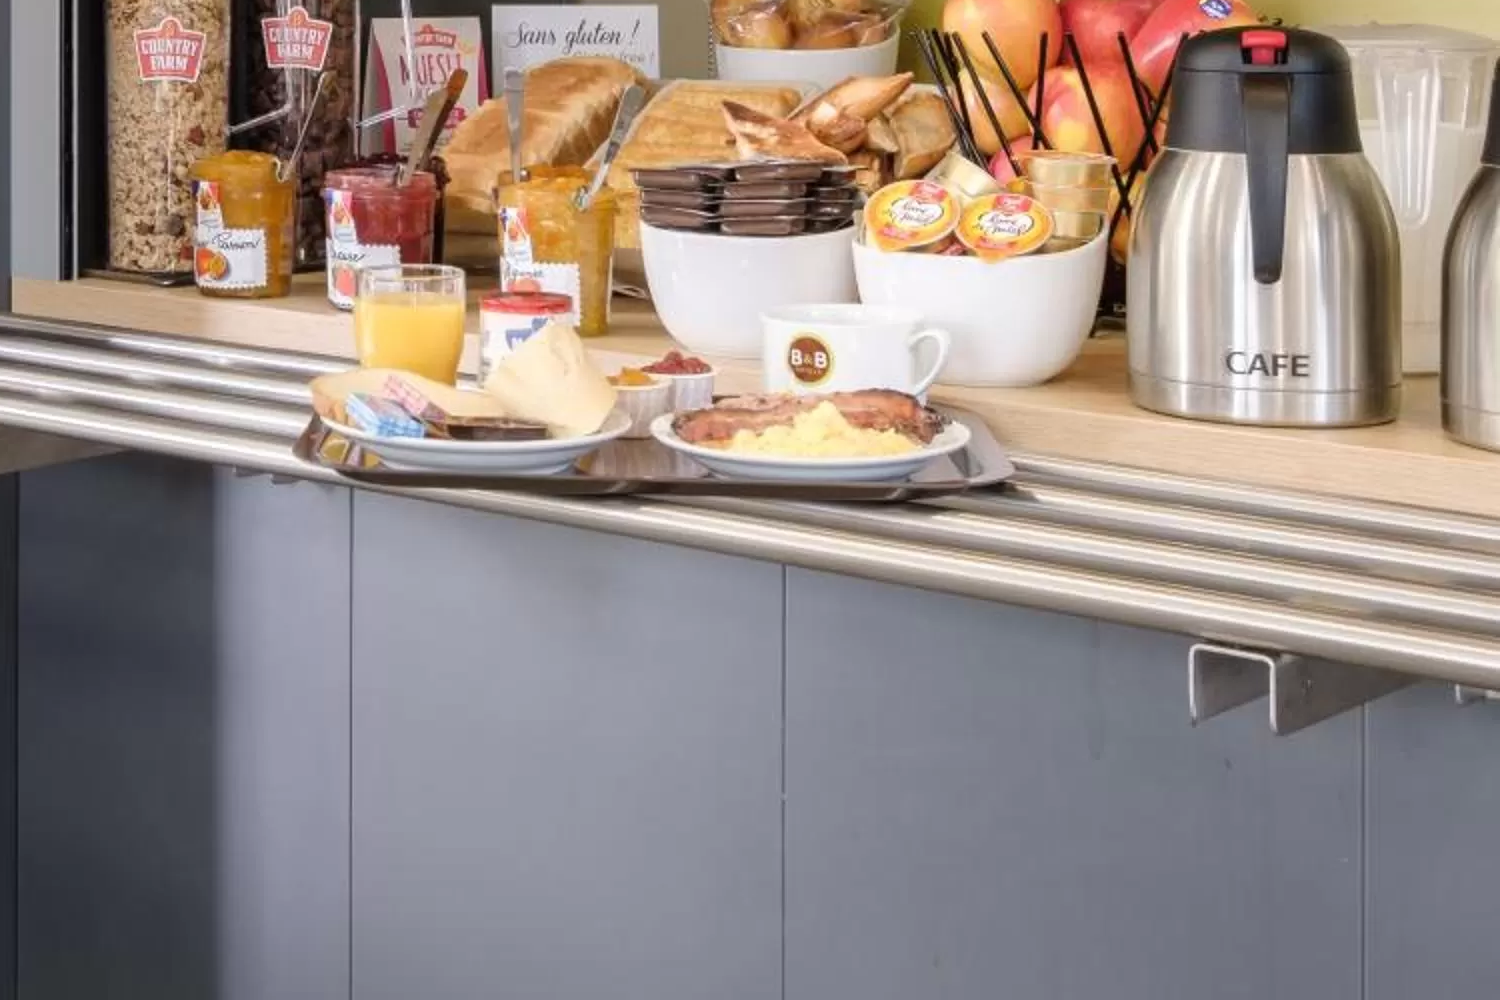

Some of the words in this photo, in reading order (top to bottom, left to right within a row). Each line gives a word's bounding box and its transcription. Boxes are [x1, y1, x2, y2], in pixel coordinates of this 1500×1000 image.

[269, 27, 325, 45] COUNTRY
[506, 21, 557, 48] Sans
[564, 19, 624, 55] gluten
[140, 38, 199, 57] COUNTRY
[277, 43, 313, 60] FARM
[150, 55, 188, 72] FARM
[791, 348, 828, 369] B&B
[1225, 351, 1311, 377] CAFE
